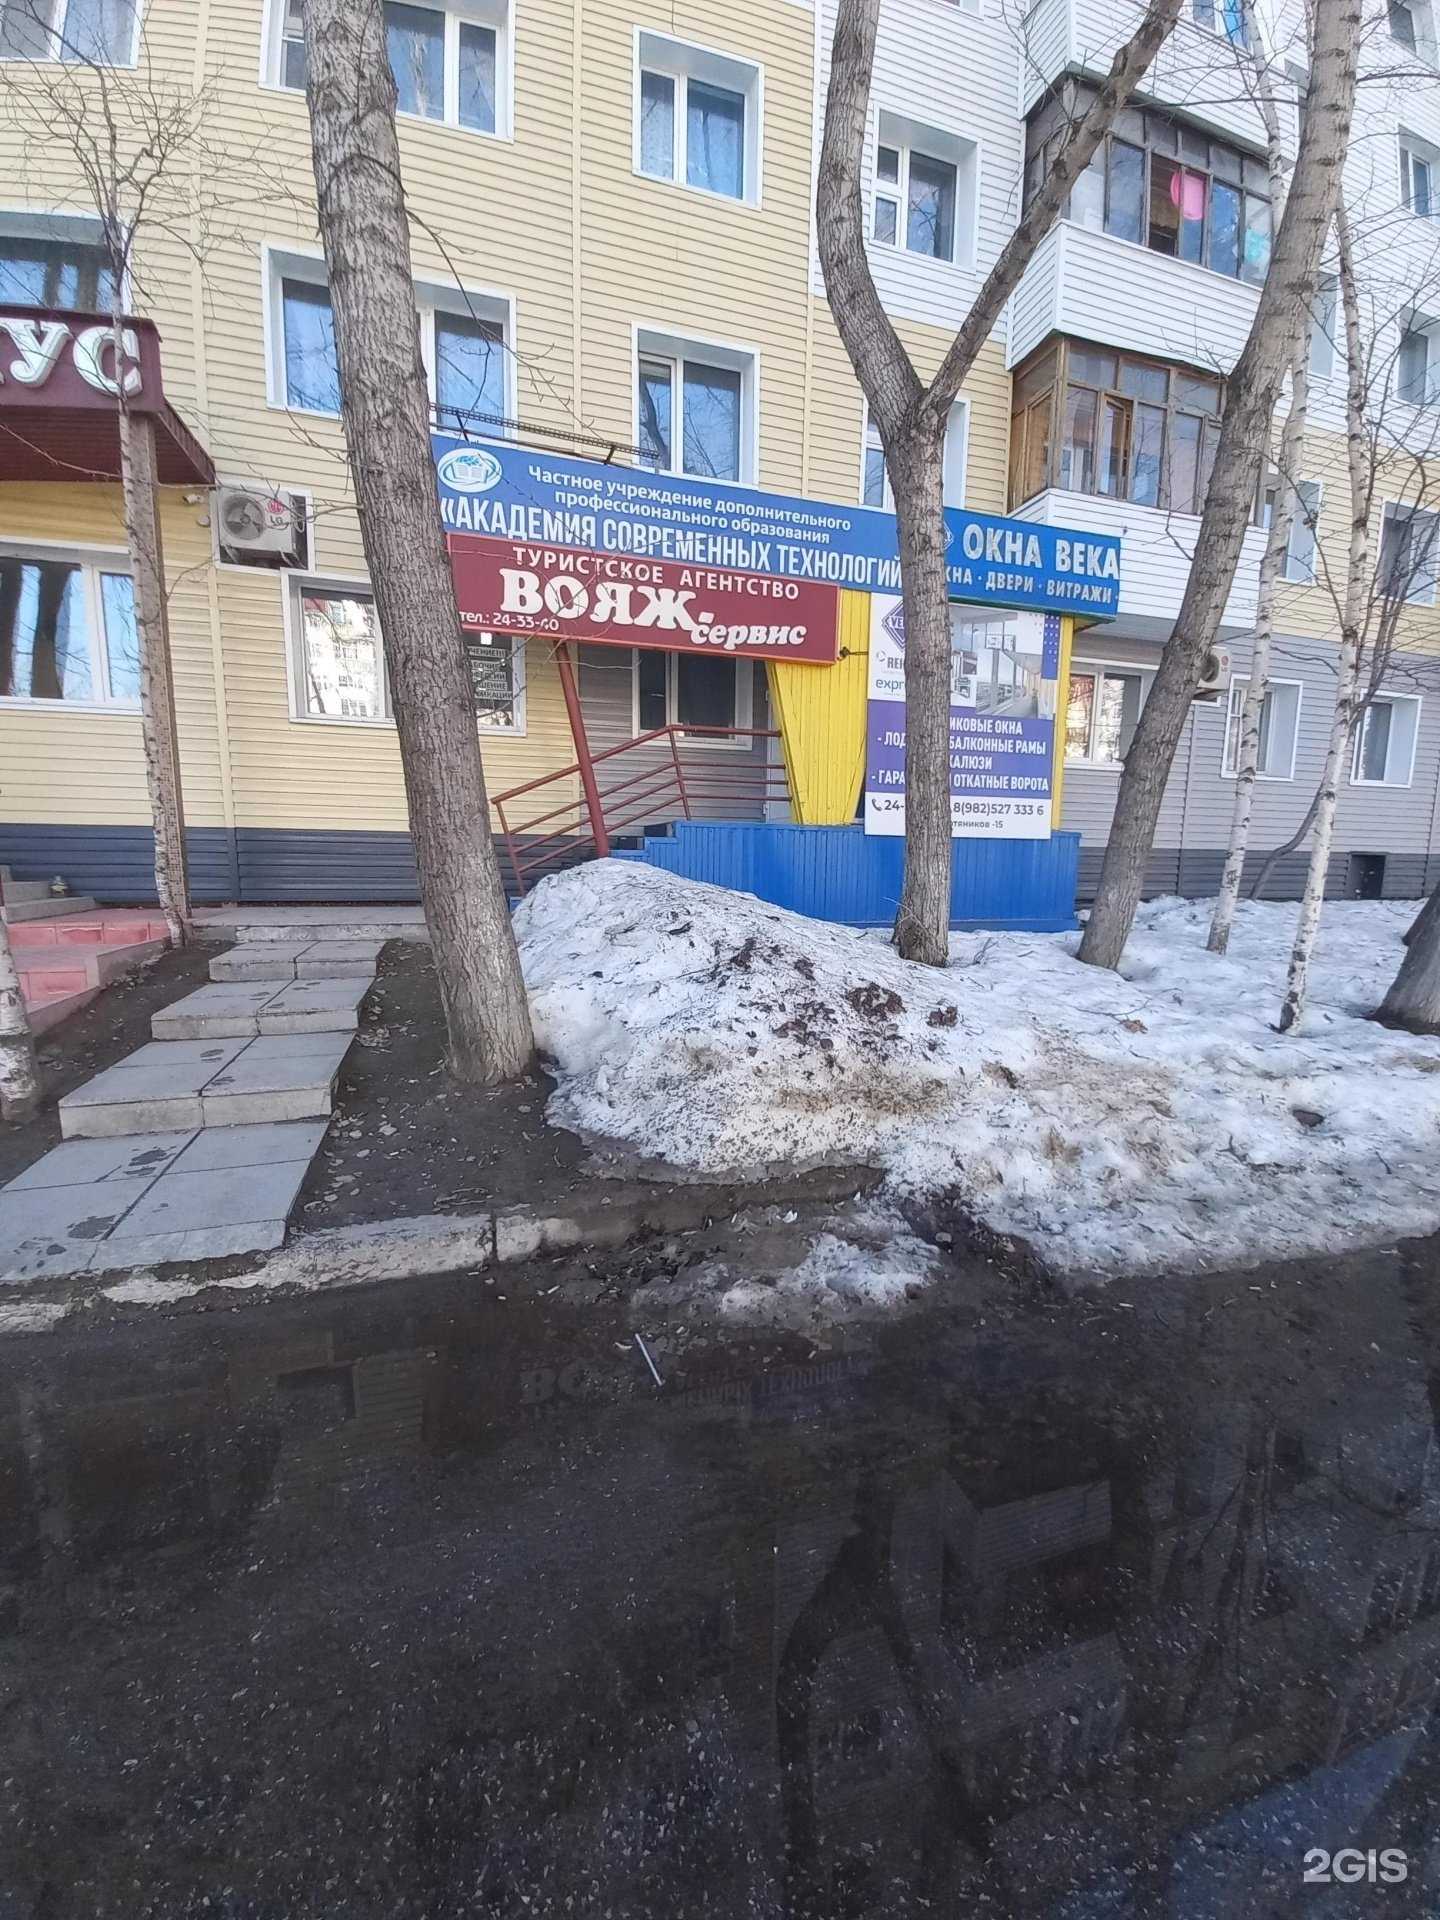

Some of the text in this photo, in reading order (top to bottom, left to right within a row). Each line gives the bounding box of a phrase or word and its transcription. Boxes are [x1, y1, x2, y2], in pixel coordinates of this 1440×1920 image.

[0, 316, 142, 398] УС
[528, 465, 851, 531] Частное учреждение дополнительного
[555, 491, 830, 544] профессионального образования
[513, 546, 799, 600] ТУРИСТСКОЕ АГЕНТСТВО
[602, 518, 771, 572] СОВРЕМЕННЫХ
[776, 544, 903, 589] ТЕХНОЛОГИЙ
[963, 524, 1120, 580] ОКНА ВЕКА
[986, 571, 1034, 593] ДВЕРИ
[1047, 579, 1112, 604] ВИТРАЖИ
[876, 679, 904, 692] expr
[884, 731, 1046, 755] ЛОД БАЛКОННЫЕ РАМЫ
[950, 717, 1023, 735] ИКОВЫЕ ОКНА
[879, 769, 1049, 791] ГАРА ОТКАТНЫЕ ВОРОТА
[884, 799, 1044, 816] 24- 8(982)527 333 6
